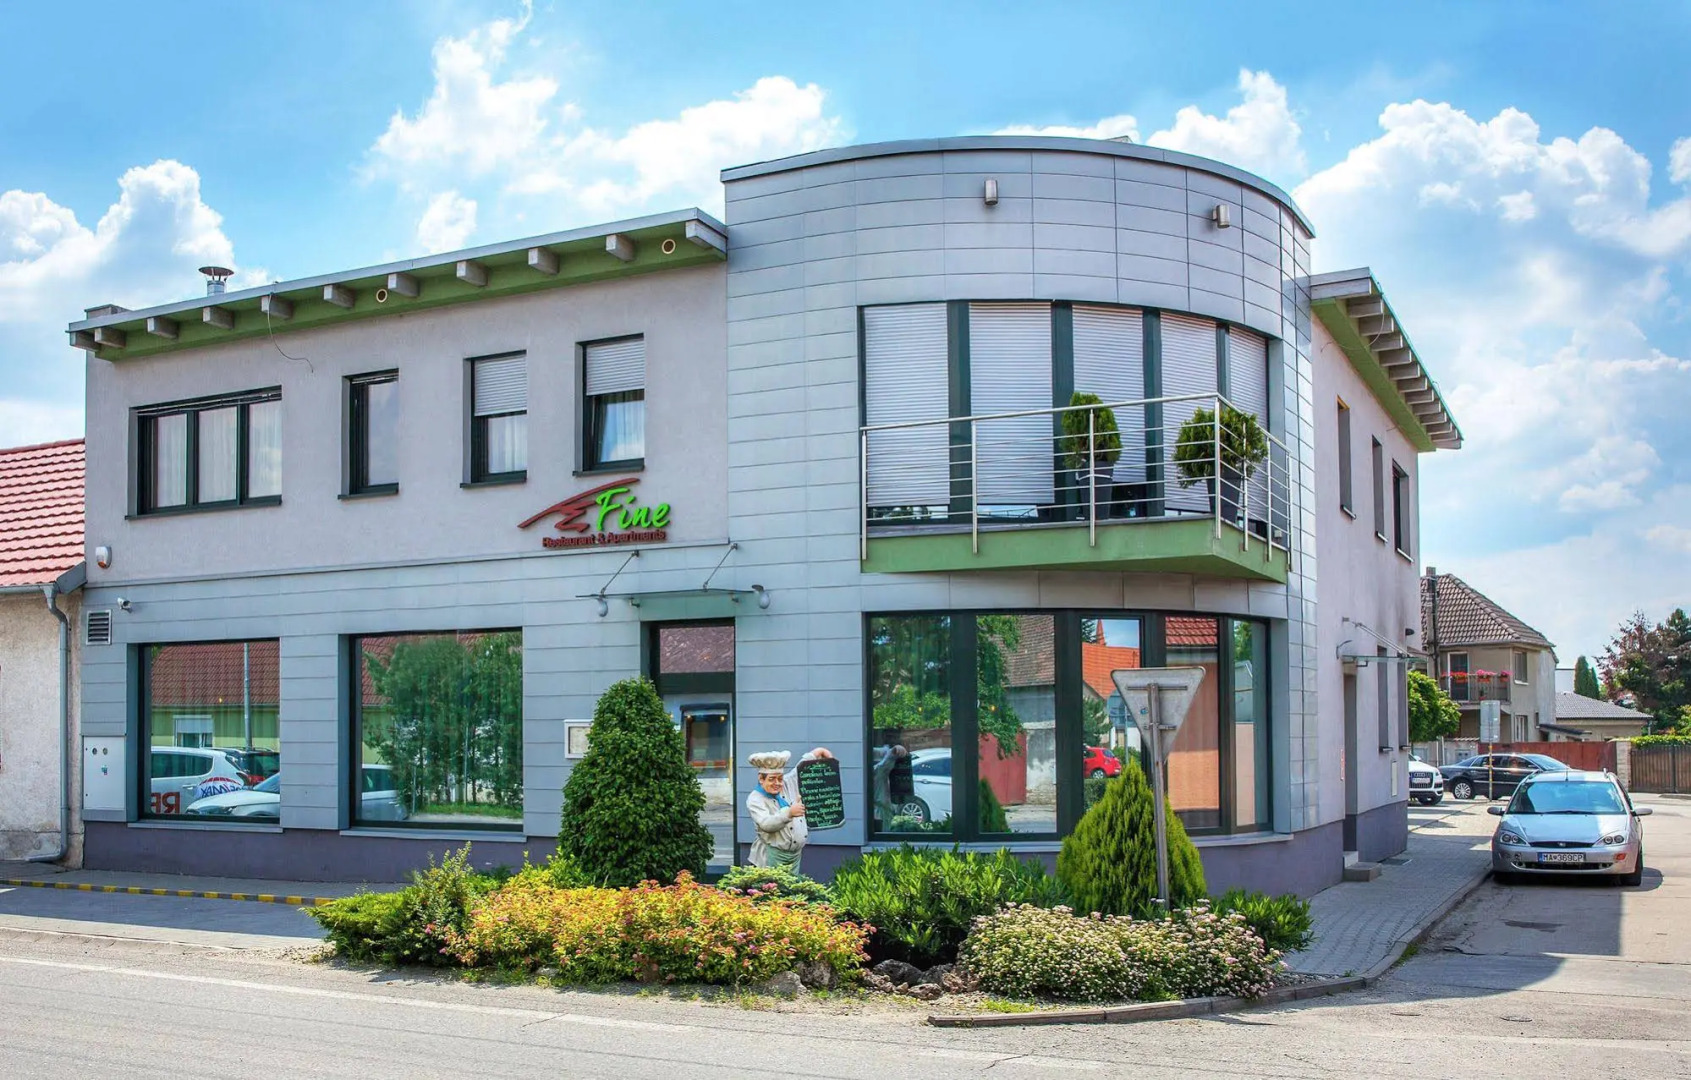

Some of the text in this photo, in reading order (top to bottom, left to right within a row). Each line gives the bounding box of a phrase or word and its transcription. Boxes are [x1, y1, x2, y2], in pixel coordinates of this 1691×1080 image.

[595, 487, 671, 531] Fine
[542, 529, 666, 548] Restaurant & Apartments
